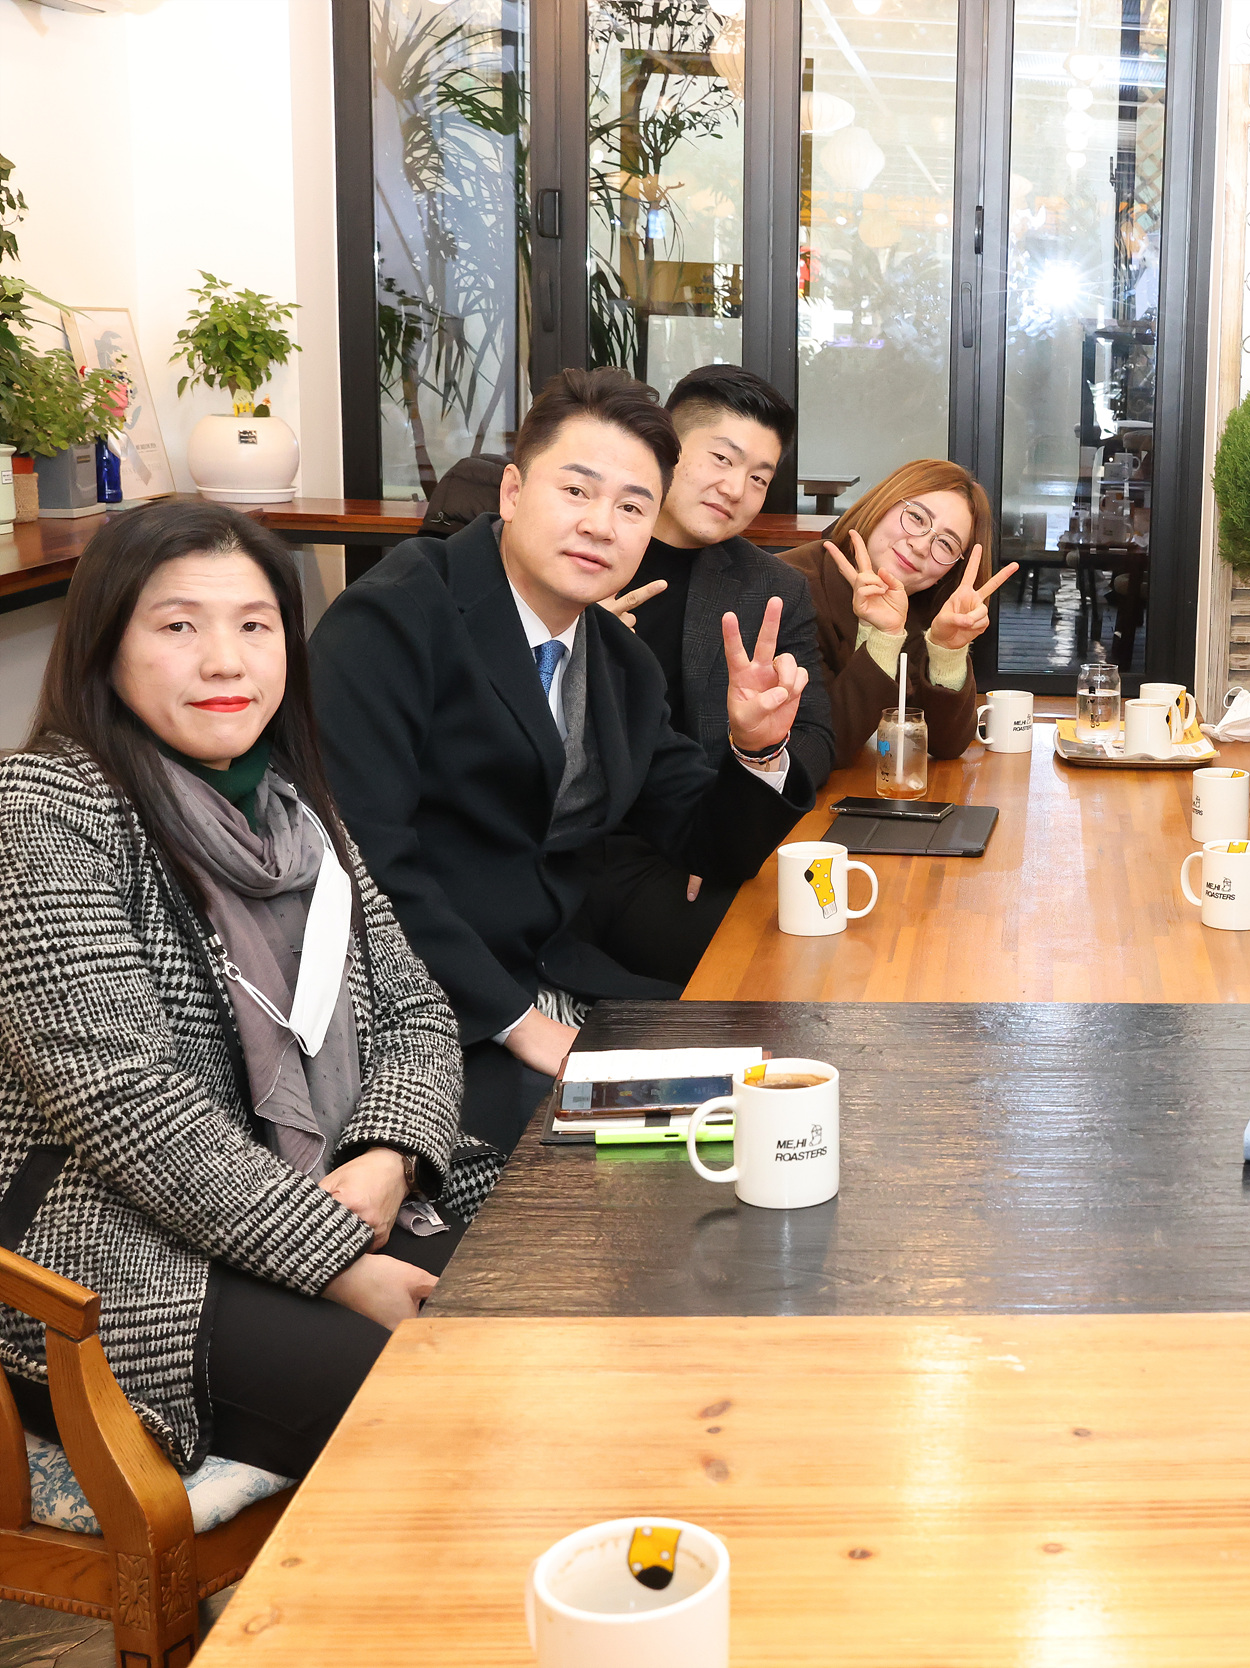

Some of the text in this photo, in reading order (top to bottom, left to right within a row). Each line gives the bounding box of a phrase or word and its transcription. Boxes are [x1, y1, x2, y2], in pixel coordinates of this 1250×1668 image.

[1205, 889, 1236, 901] ROASTERS
[776, 1138, 807, 1149] ME,HI
[775, 1146, 828, 1162] ROASTERS
